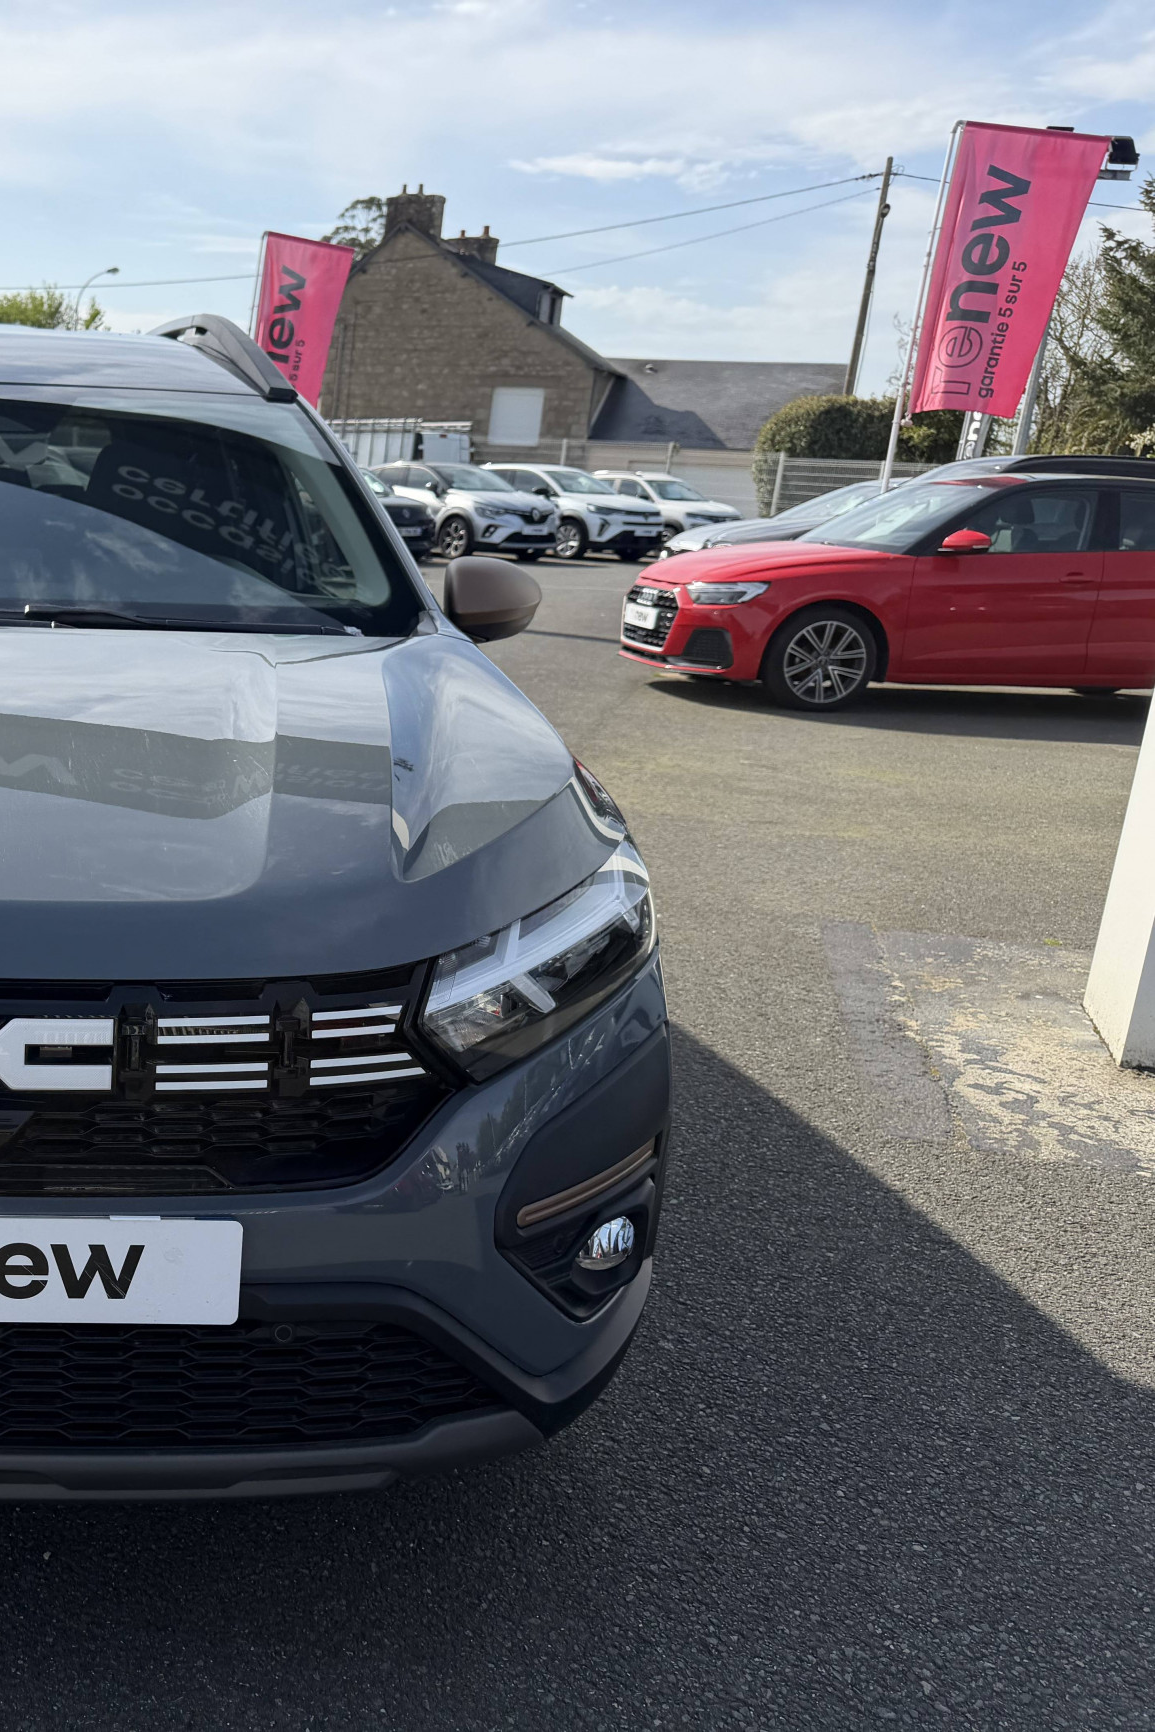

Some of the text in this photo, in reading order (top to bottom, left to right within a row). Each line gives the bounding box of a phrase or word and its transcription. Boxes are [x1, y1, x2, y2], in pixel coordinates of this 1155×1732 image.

[931, 163, 1032, 397] renew
[978, 261, 1028, 399] garantie 5 sur 5
